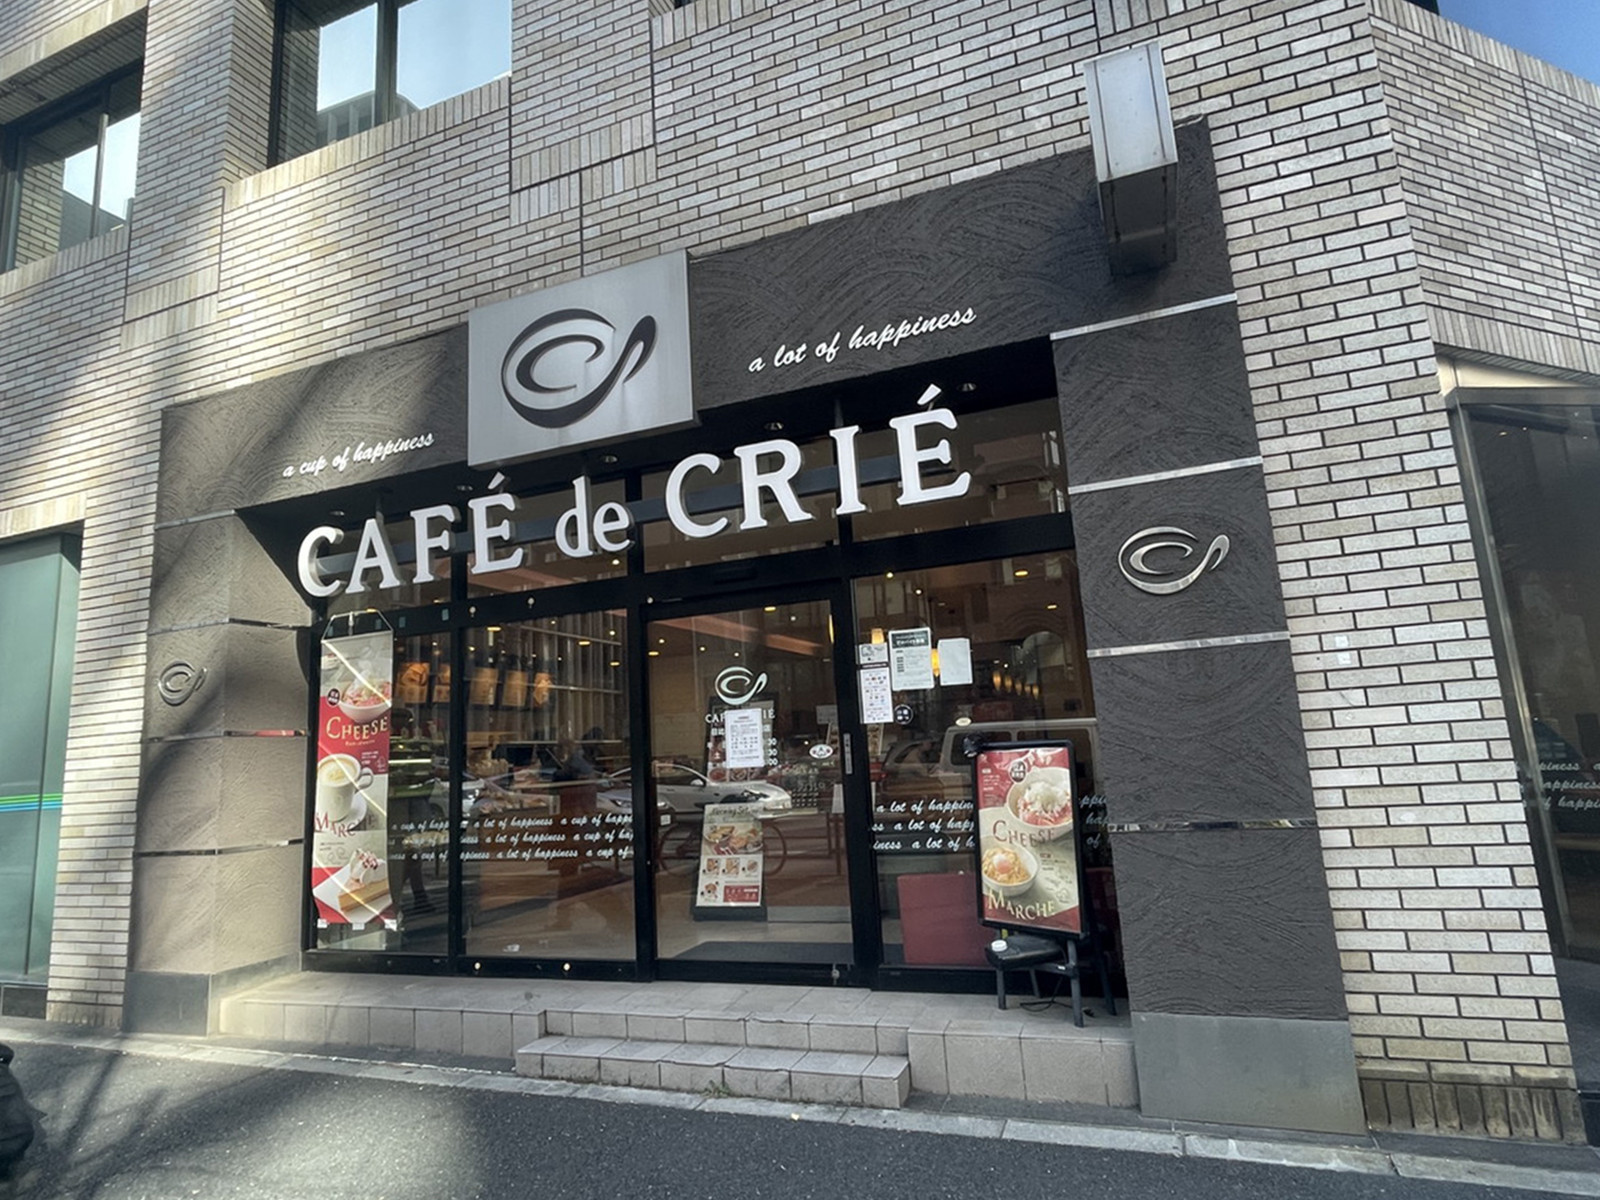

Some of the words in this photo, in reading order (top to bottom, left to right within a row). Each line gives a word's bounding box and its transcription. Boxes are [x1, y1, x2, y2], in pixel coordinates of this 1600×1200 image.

[749, 357, 765, 372] a
[774, 344, 807, 367] lot
[815, 331, 840, 362] of
[848, 307, 977, 350] happiness
[282, 465, 296, 478] a
[299, 455, 328, 477] cup
[332, 446, 350, 472] of
[353, 432, 435, 463] happiness
[297, 472, 524, 599] CAFÉ
[555, 475, 633, 558] de
[665, 383, 972, 539] CRIÉ
[325, 715, 389, 740] CHEESE
[876, 804, 885, 813] a
[890, 801, 907, 813] lot
[911, 799, 924, 815] of
[510, 816, 553, 829] happiness
[560, 817, 568, 825] a
[571, 815, 588, 827] cup
[591, 813, 602, 827] of
[894, 823, 903, 831] a
[908, 819, 925, 830] lot
[929, 818, 942, 833] of
[510, 832, 520, 846] of
[522, 831, 566, 845] happiness
[573, 833, 580, 841] a
[584, 832, 601, 843] cup
[605, 829, 615, 843] of
[992, 819, 1056, 848] CHEESE
[912, 841, 921, 849] a
[926, 837, 942, 848] lot
[947, 836, 961, 852] of
[522, 848, 532, 861] of
[534, 847, 579, 860] happiness
[586, 849, 593, 857] a
[597, 847, 614, 859] cup
